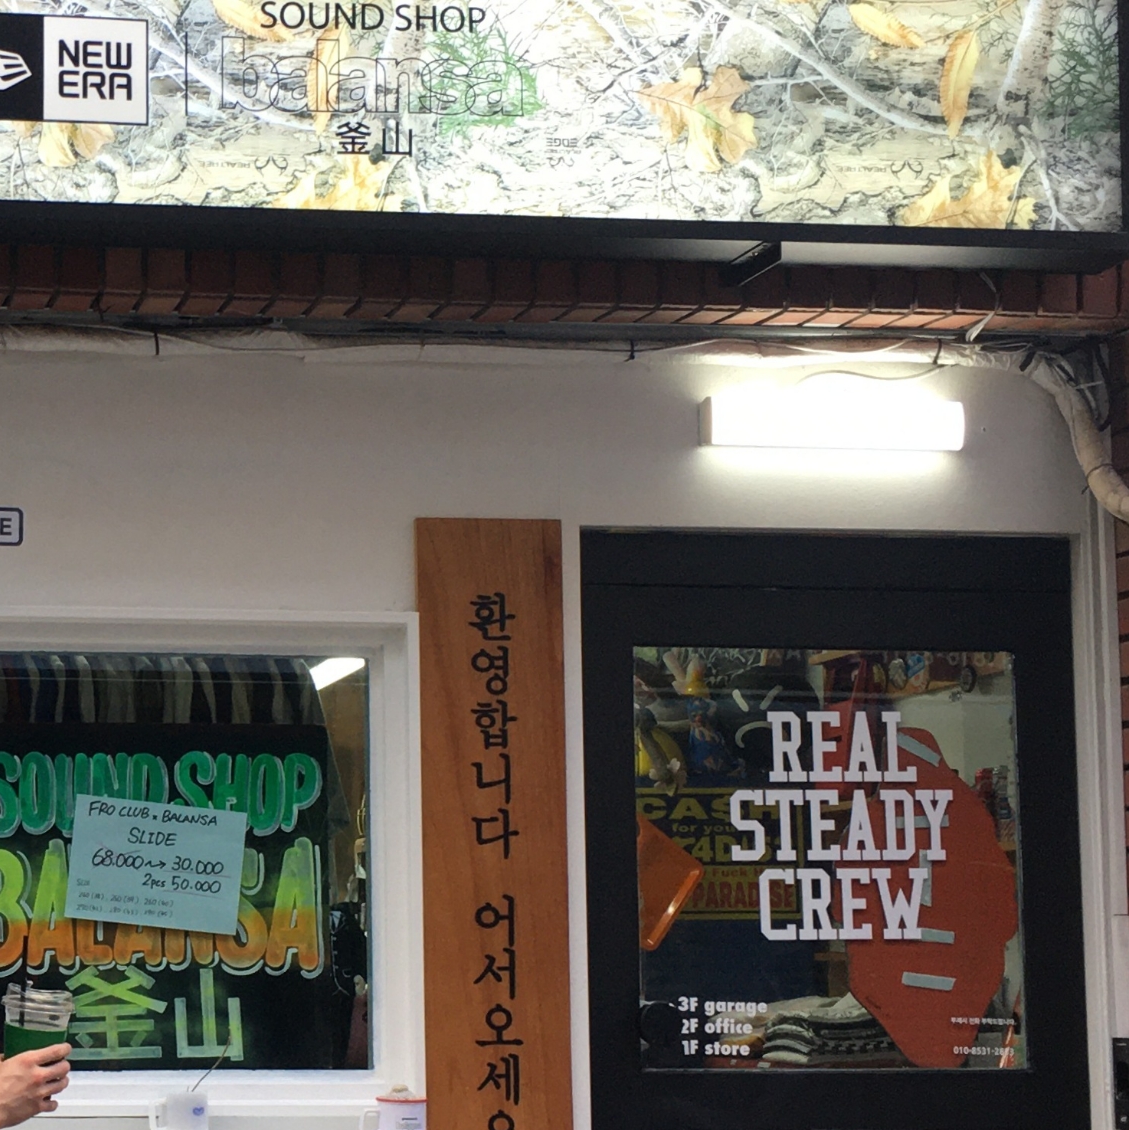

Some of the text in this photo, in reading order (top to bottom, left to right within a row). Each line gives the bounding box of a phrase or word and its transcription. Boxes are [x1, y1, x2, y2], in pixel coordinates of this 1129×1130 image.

[261, 2, 486, 33] SOUND SHOP
[58, 39, 133, 69] NEW
[58, 72, 133, 101] ERA
[219, 36, 524, 117] balansa
[335, 121, 413, 157] 釜山
[469, 591, 519, 859] 환영합니다
[767, 711, 917, 782] REAL
[173, 750, 323, 836] SHOP
[88, 800, 116, 816] FRO
[118, 805, 150, 819] CLUB
[161, 809, 218, 826] BALANSA
[729, 789, 953, 861] STEADY
[127, 826, 178, 847] SLIDE
[672, 823, 697, 833] for
[91, 847, 224, 875] 68.000 30.000
[712, 868, 747, 877] Fuck
[171, 875, 222, 894] 50.000
[692, 880, 793, 909] PARADSE
[759, 868, 929, 941] CREW
[65, 964, 245, 1061] 釜山
[677, 996, 768, 1016] 3F garage
[681, 1019, 754, 1035] 2F office
[681, 1040, 751, 1057] 1F store
